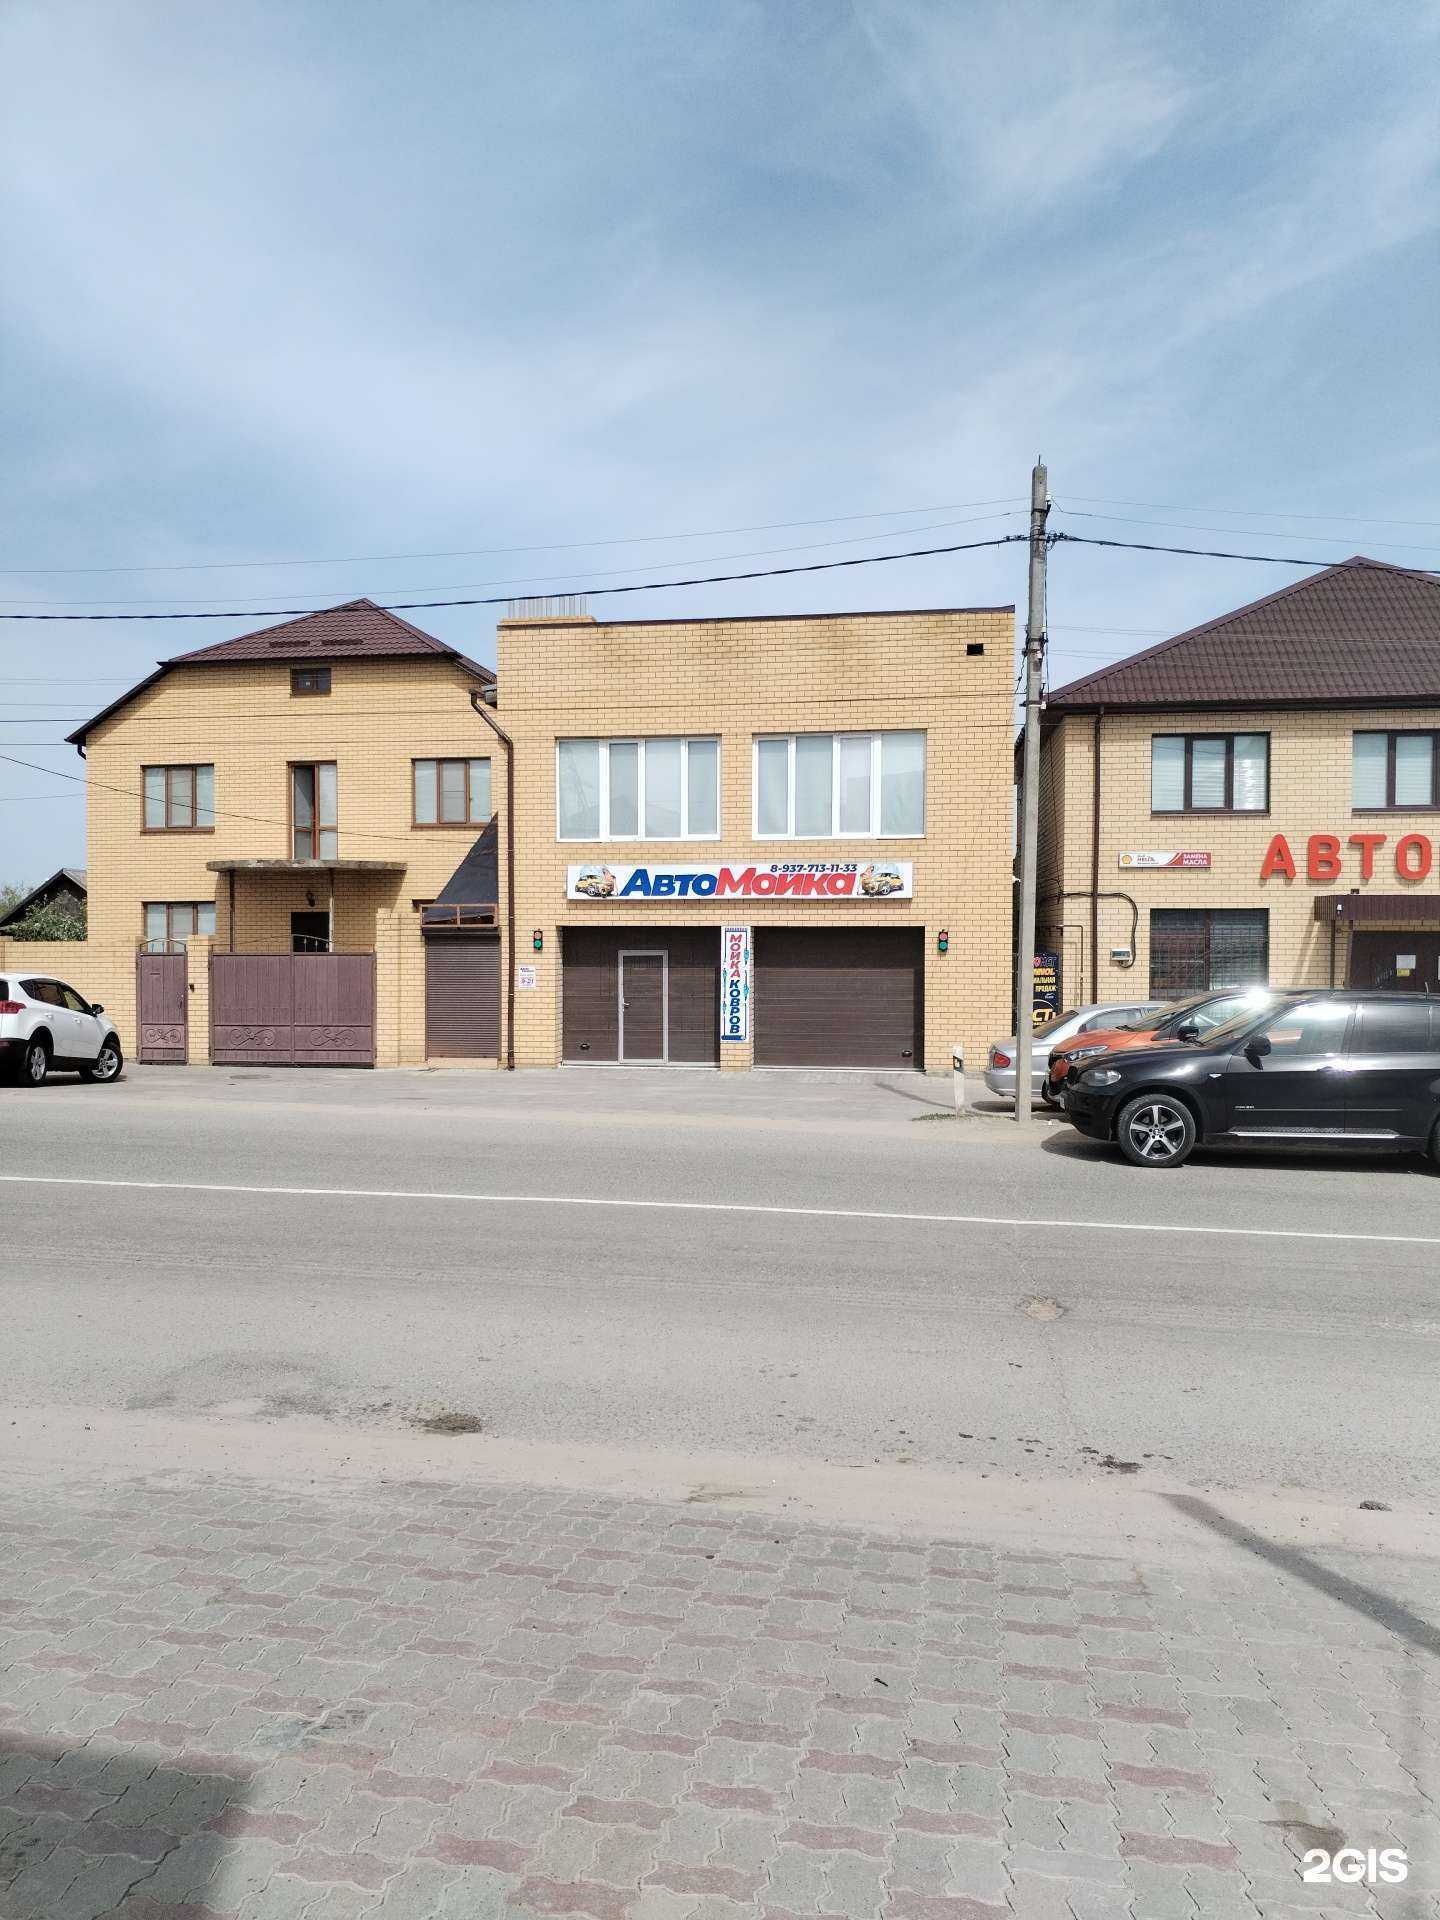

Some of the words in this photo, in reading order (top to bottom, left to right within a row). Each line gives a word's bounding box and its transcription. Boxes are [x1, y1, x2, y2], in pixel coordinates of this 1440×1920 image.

[769, 863, 858, 873] 8-937-713-11-33
[1260, 833, 1433, 880] АВТО
[728, 979, 741, 1034] КОВРОВ
